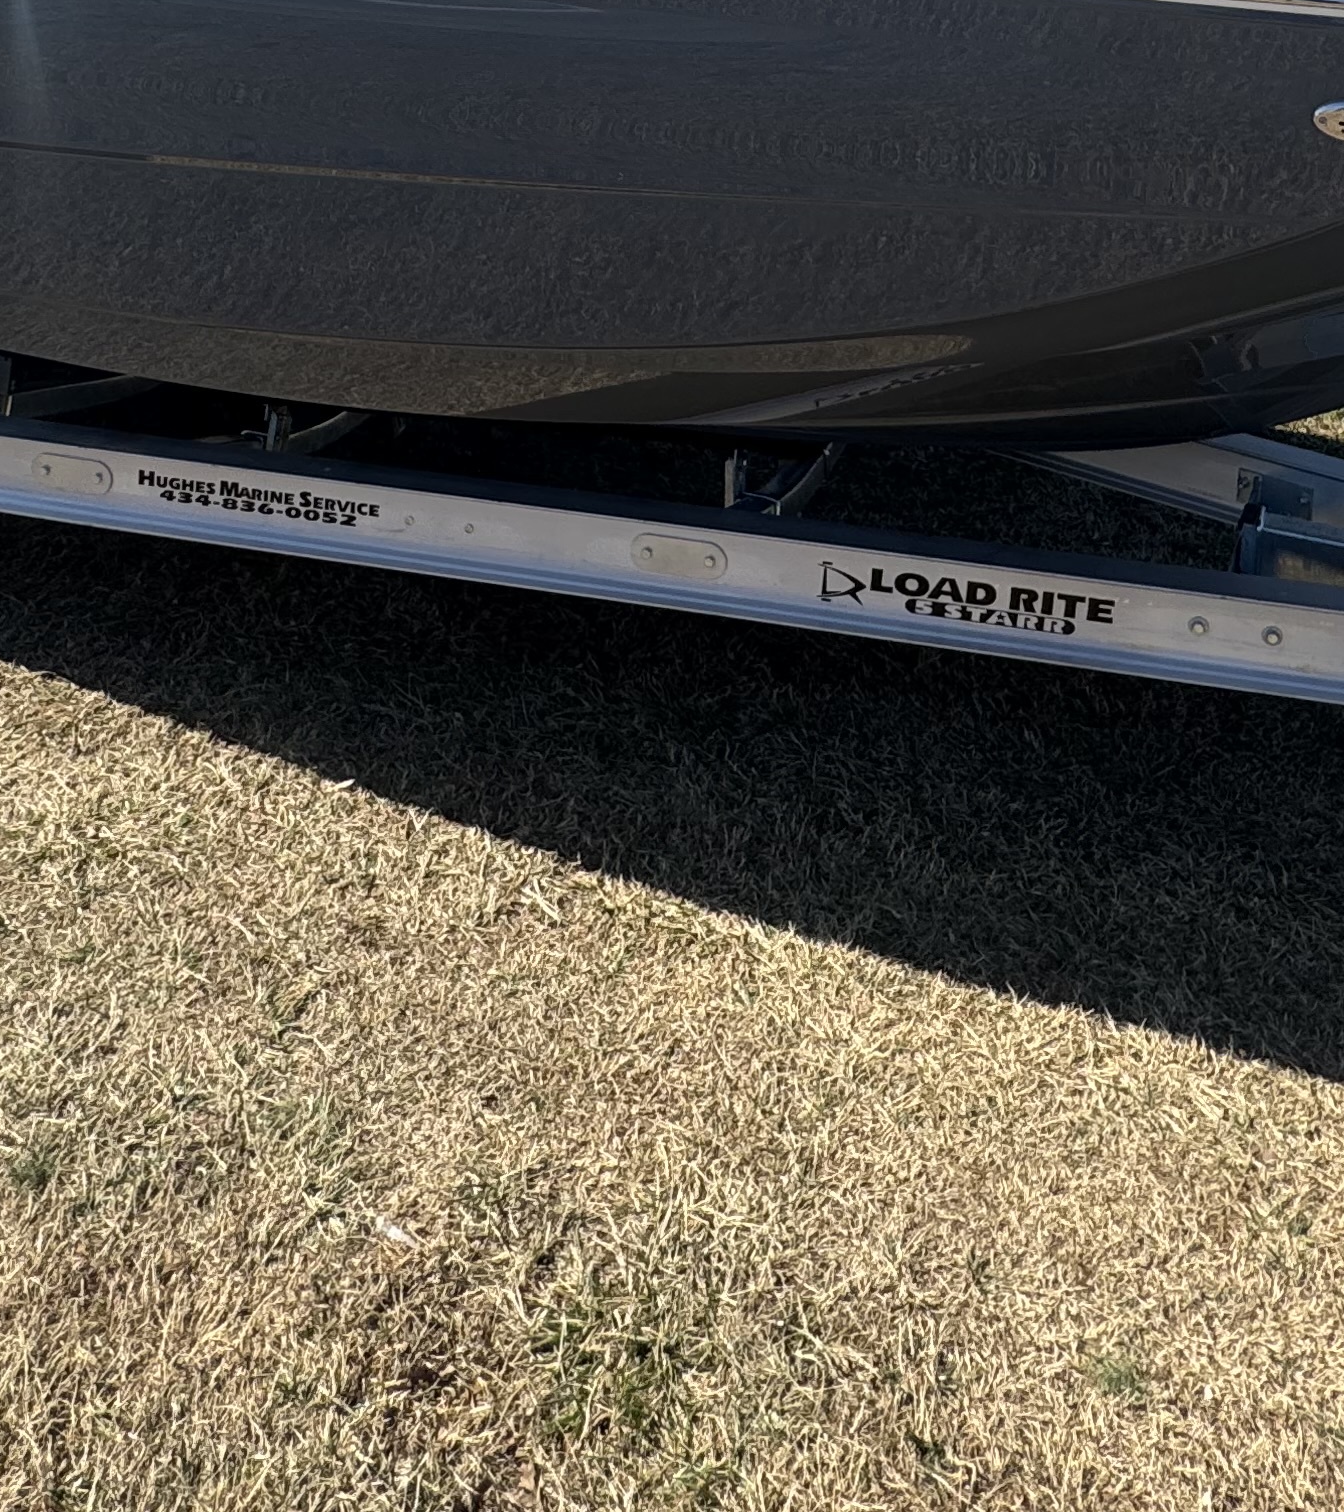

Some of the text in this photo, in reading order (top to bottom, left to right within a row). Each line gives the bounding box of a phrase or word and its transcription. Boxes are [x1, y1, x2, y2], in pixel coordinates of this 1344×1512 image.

[138, 470, 380, 517] HUGHES MARINE SERVICE
[159, 490, 357, 527] 434-836-0052
[869, 568, 1115, 624] LOAD RITE
[914, 599, 1067, 635] 5 STARR
